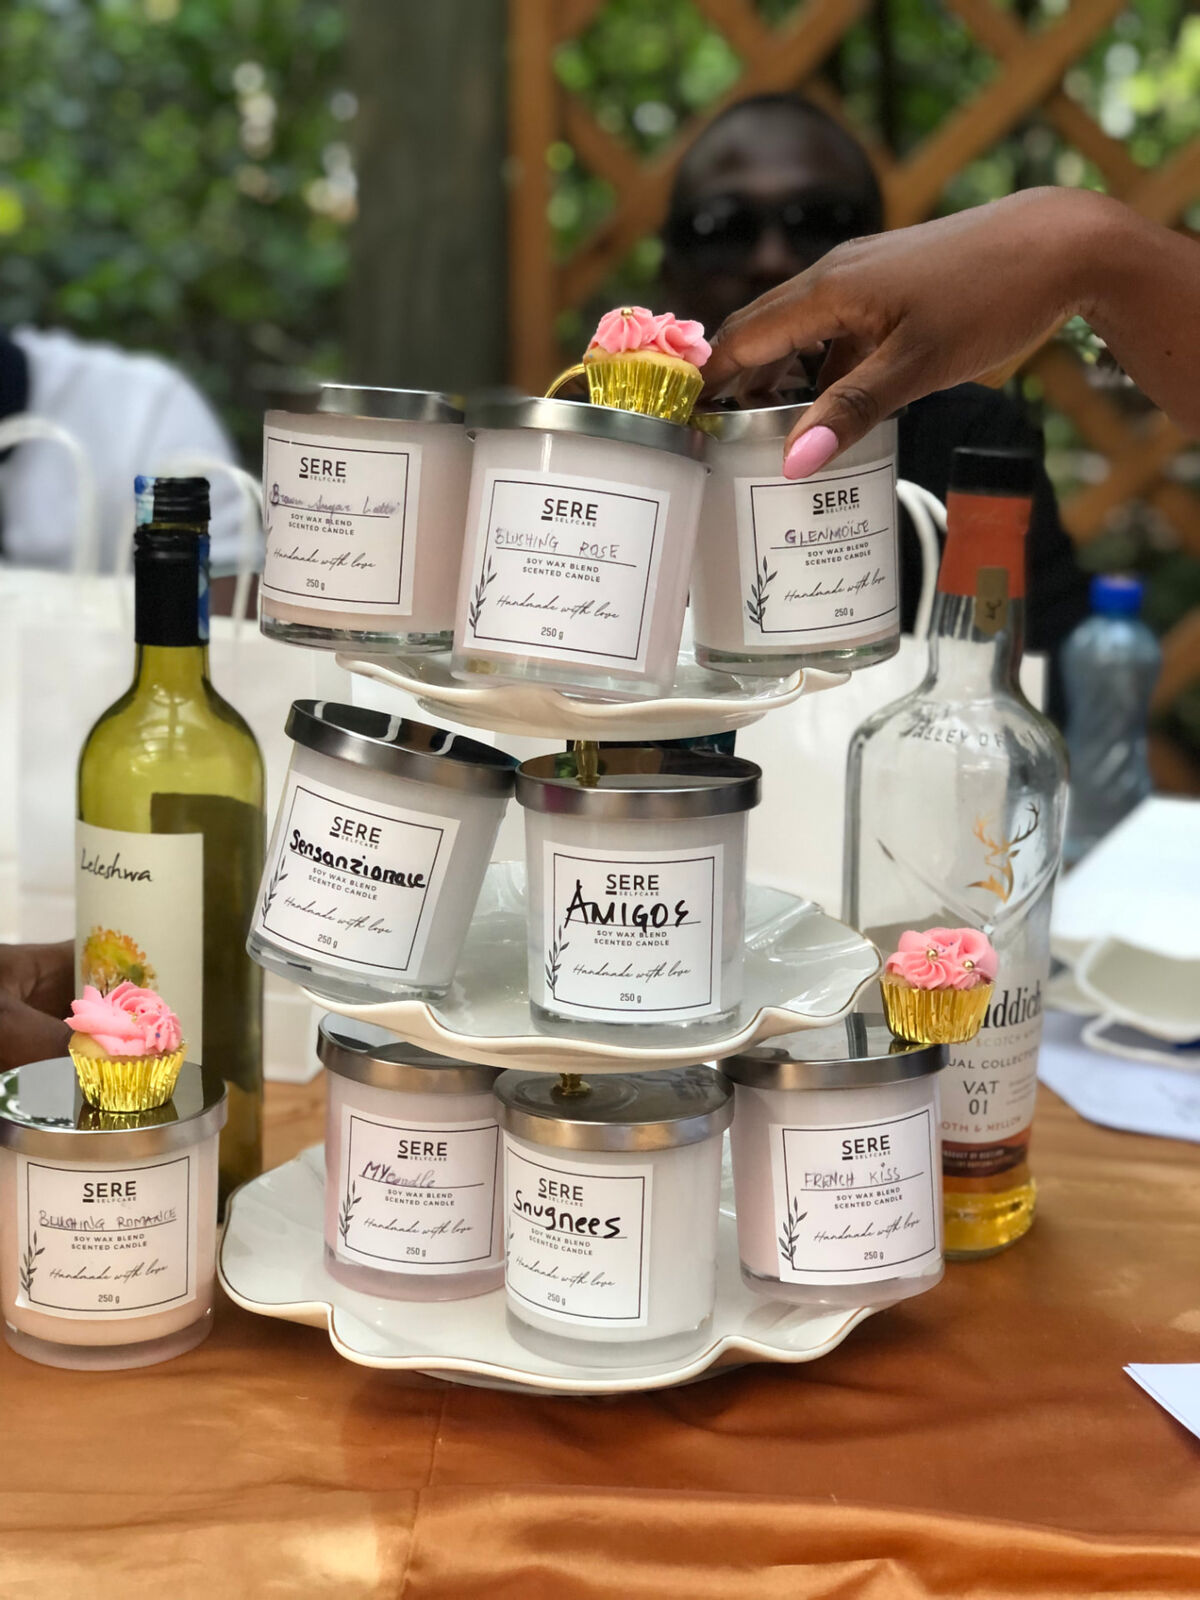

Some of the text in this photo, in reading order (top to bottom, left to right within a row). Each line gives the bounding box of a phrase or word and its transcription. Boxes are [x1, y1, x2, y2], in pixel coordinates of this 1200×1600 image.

[299, 457, 347, 478] SERE
[813, 487, 860, 509] SERE
[542, 498, 598, 521] SERE
[288, 522, 355, 536] SCENTED CANDLE
[325, 518, 352, 526] BLEND
[494, 527, 620, 559] BLUSHING ROSE
[808, 542, 869, 558] SOY WAX BLEND
[274, 546, 376, 571] Handmade with love
[526, 557, 600, 573] SOY WAX BLEND
[805, 550, 871, 566] SCENTED CANDLE
[522, 566, 600, 583] SCENTED CANDLE
[306, 578, 320, 589] 250
[784, 568, 886, 602] Handmade with love
[496, 592, 620, 620] Handmade with love
[834, 607, 848, 618] 250
[541, 626, 557, 638] 250
[331, 816, 382, 844] SERE
[80, 848, 153, 882] Leleshwa
[312, 867, 378, 891] SOY WAX BLEND
[606, 874, 659, 890] SERE
[308, 875, 378, 901] SCENTED CANDLE
[564, 879, 689, 933] AMIGOS
[284, 896, 392, 934] Handmade with love
[317, 933, 332, 945] 250
[594, 938, 632, 946] SCENTED
[572, 960, 691, 983] Handmade with love
[620, 993, 634, 1002] 250
[963, 1080, 999, 1095] VAT
[398, 1140, 448, 1156] SERE
[842, 1135, 891, 1155] SERE
[804, 1172, 855, 1189] FRENCH
[83, 1181, 137, 1198] SERE
[538, 1178, 584, 1201] SERE
[876, 1187, 901, 1196] BLEND
[385, 1196, 420, 1206] SCENTED
[834, 1195, 903, 1210] SCENTED CANDLE
[513, 1189, 621, 1239] Snugnees
[364, 1218, 474, 1239] Handmade with love
[814, 1212, 920, 1243] Handmade with love
[114, 1241, 147, 1250] CANDLE
[117, 1233, 145, 1242] BLEND
[529, 1235, 593, 1256] SCENTED CANDLE
[531, 1228, 591, 1247] SOY WAX BLEND
[406, 1246, 420, 1256] 250
[864, 1250, 878, 1260] 250
[49, 1259, 168, 1283] Handmade with love
[515, 1256, 616, 1288] Handmade with love
[98, 1294, 113, 1303] 250
[547, 1292, 560, 1303] 250
